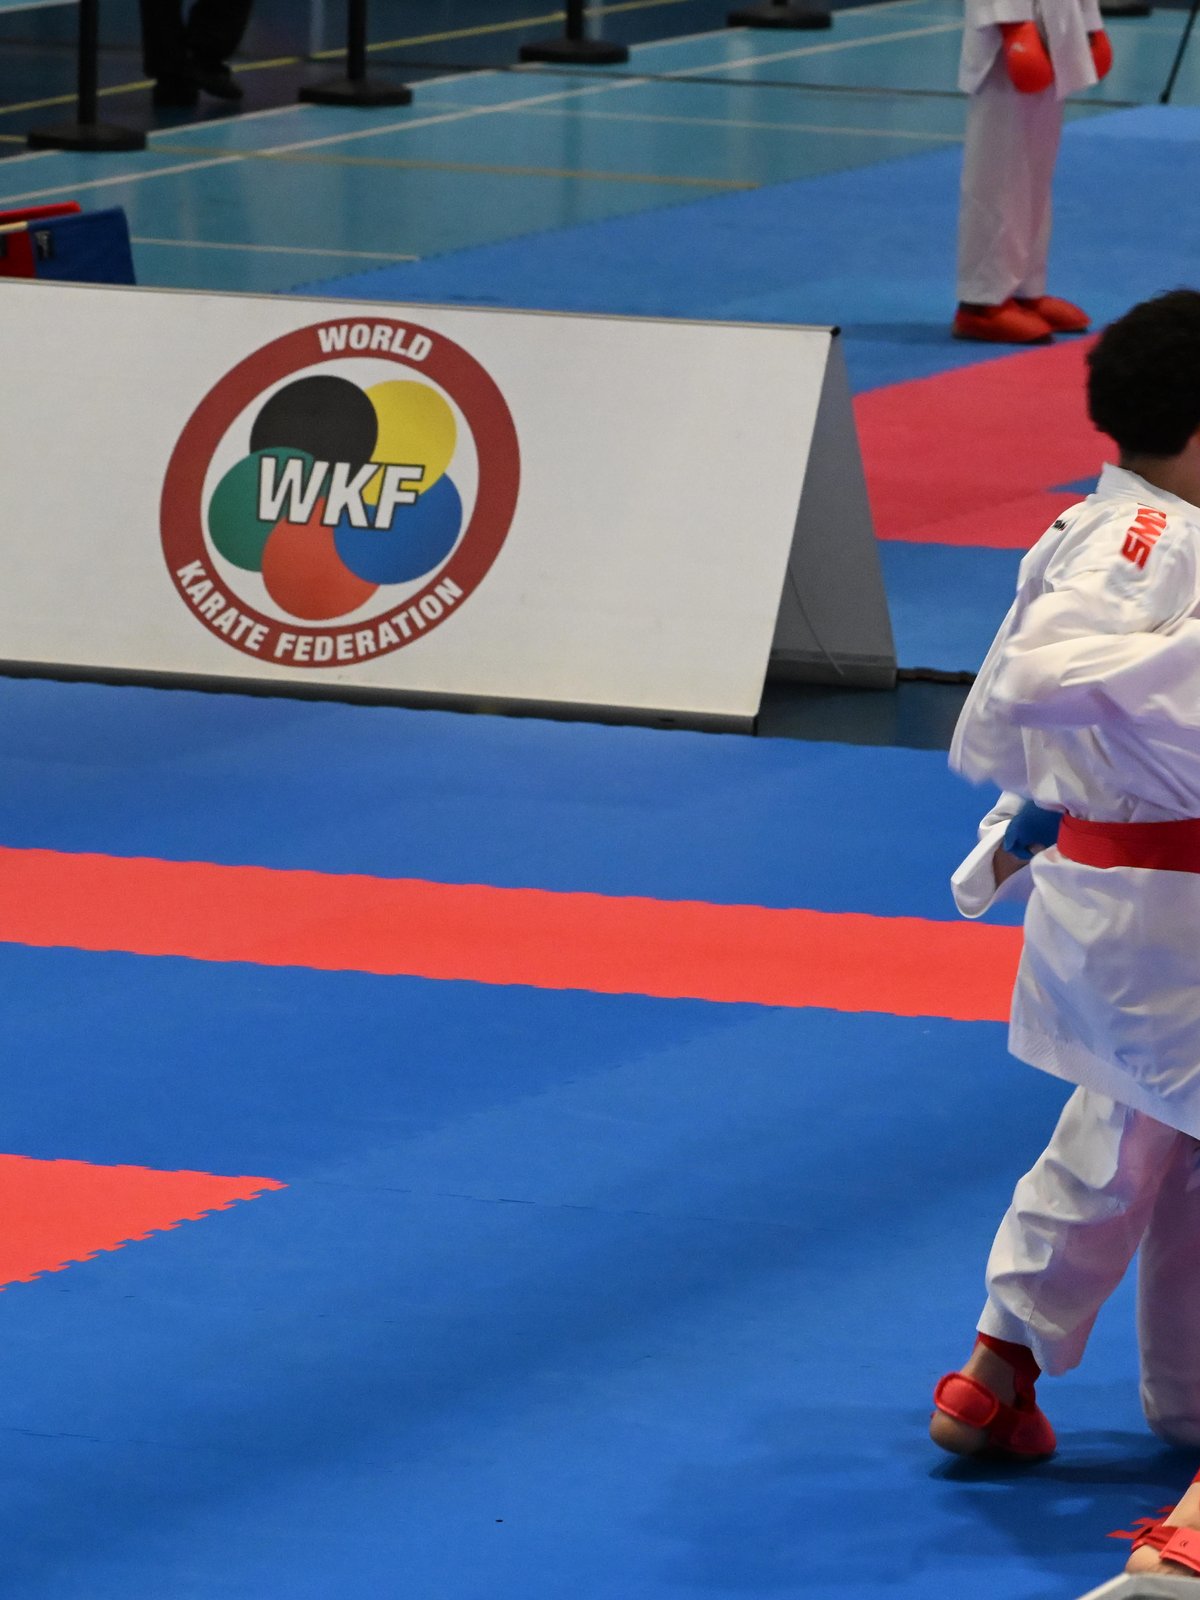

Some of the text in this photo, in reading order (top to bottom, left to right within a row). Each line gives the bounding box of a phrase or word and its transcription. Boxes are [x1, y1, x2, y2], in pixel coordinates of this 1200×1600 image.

[317, 323, 433, 362] WORLD
[256, 454, 427, 532] WKF
[176, 559, 464, 662] KARATE FEDERATION
